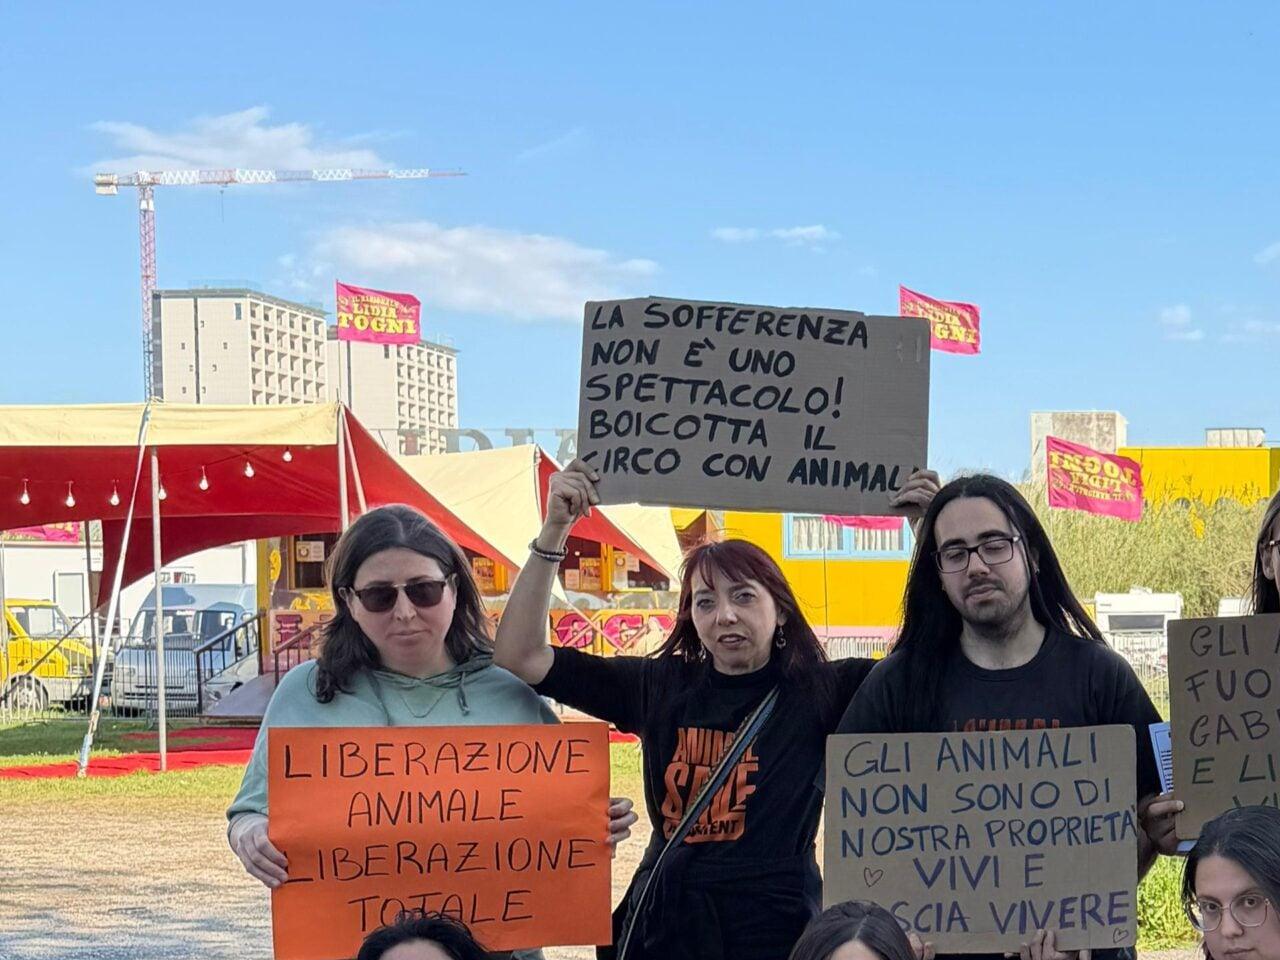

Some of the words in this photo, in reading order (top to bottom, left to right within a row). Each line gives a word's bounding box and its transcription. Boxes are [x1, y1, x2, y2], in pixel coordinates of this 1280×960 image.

[338, 312, 416, 334] TOGNI
[352, 303, 397, 319] LIDIA
[591, 305, 625, 330] LA
[643, 302, 868, 349] SOFFERENZA
[934, 323, 977, 344] GNI
[591, 339, 661, 367] NON
[728, 348, 795, 378] UNO
[586, 373, 844, 419] SPETTACOLO!
[589, 409, 768, 447] BOICOTTA
[804, 424, 837, 451] IL
[702, 452, 772, 482] CON
[787, 457, 919, 493] ANIMAL
[1190, 624, 1250, 657] GLI
[283, 738, 591, 779] LIBERAZIONE
[844, 740, 911, 777] GLI
[937, 731, 1098, 773] ANIMALI
[1192, 757, 1215, 785] E
[347, 788, 524, 828] ANIMALE
[840, 783, 928, 818] NON
[951, 781, 1060, 814] SONO
[1074, 778, 1110, 806] DI
[841, 823, 970, 857] NOSTRA
[984, 804, 1137, 848] PROPRIETÀ
[283, 837, 596, 883] LIBERAZIONE
[912, 856, 1000, 891] VIVI
[1024, 853, 1044, 888] E
[348, 888, 533, 932] TOTALE
[891, 901, 971, 933] SCIA
[989, 890, 1130, 935] VIVERE
